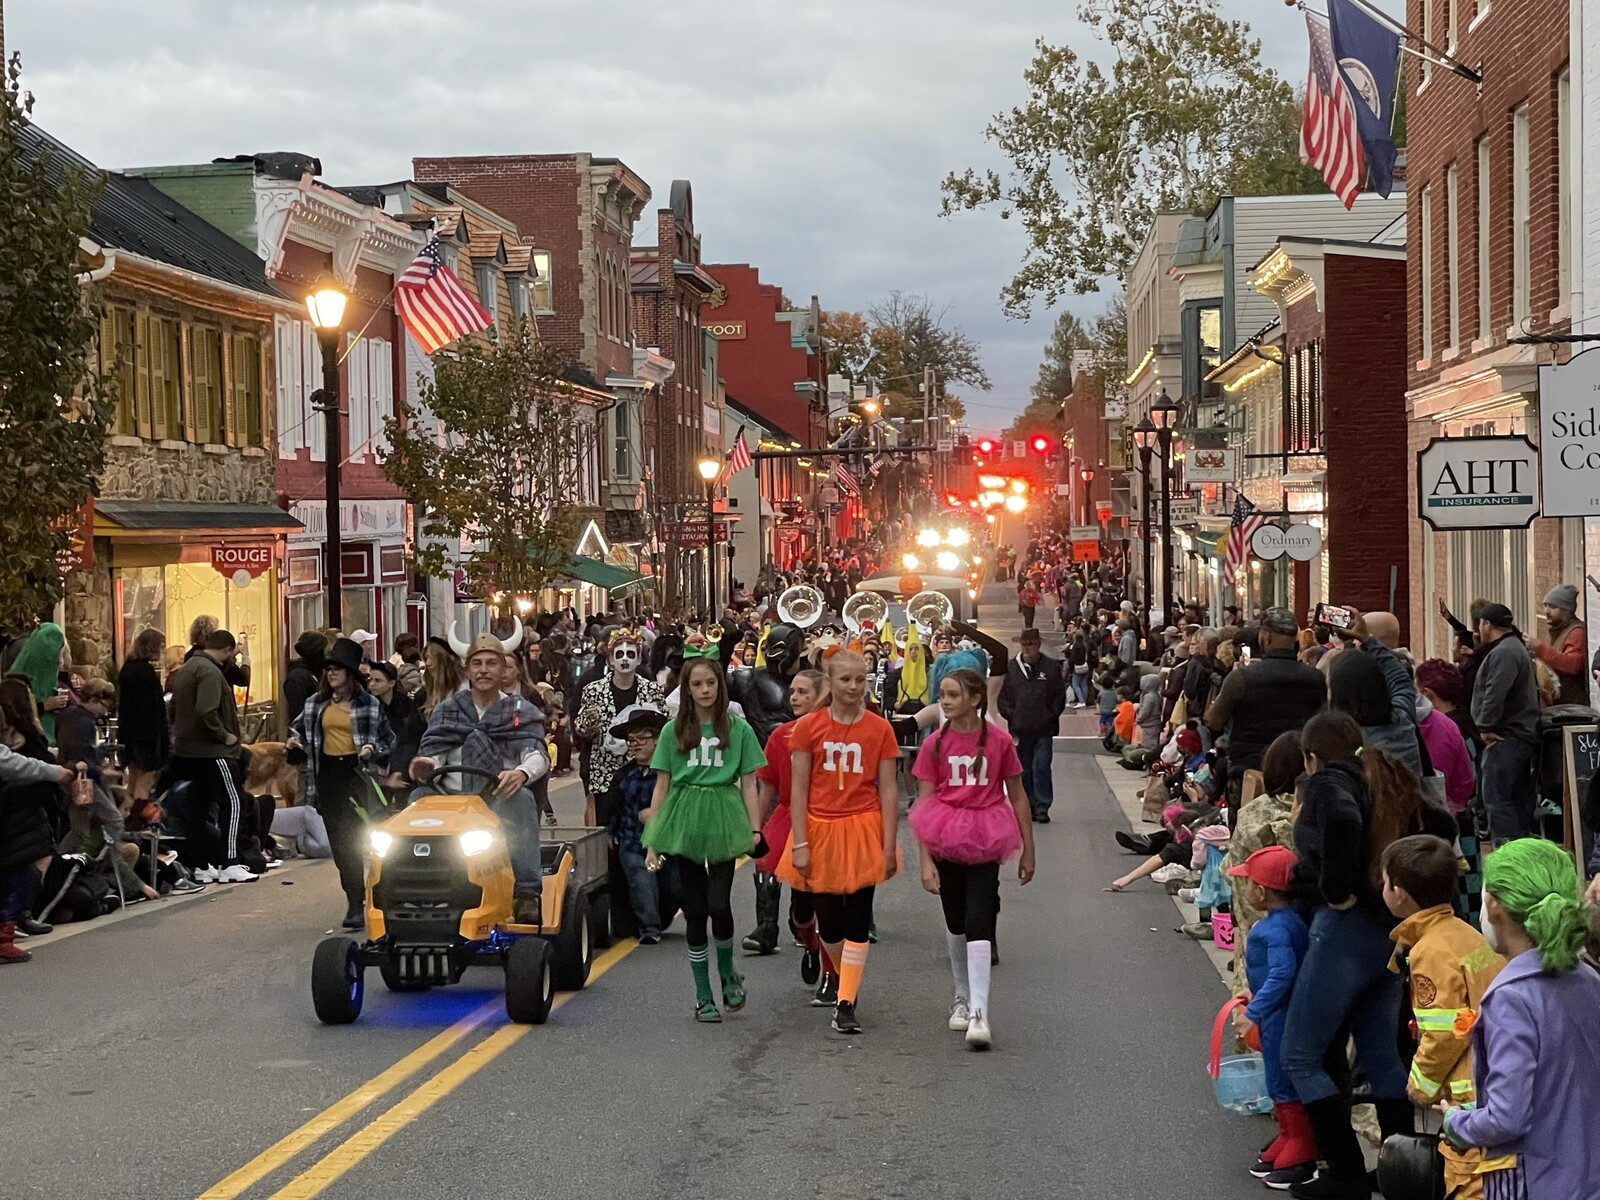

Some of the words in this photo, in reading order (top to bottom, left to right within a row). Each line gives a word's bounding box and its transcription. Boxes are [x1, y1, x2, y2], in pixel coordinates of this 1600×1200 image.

[1552, 407, 1600, 439] Sid
[1430, 459, 1529, 496] AHT
[1441, 496, 1519, 506] INSURANCE
[215, 549, 268, 562] ROUGE
[1261, 533, 1312, 548] Ordinary
[823, 741, 864, 774] m
[948, 755, 989, 786] m
